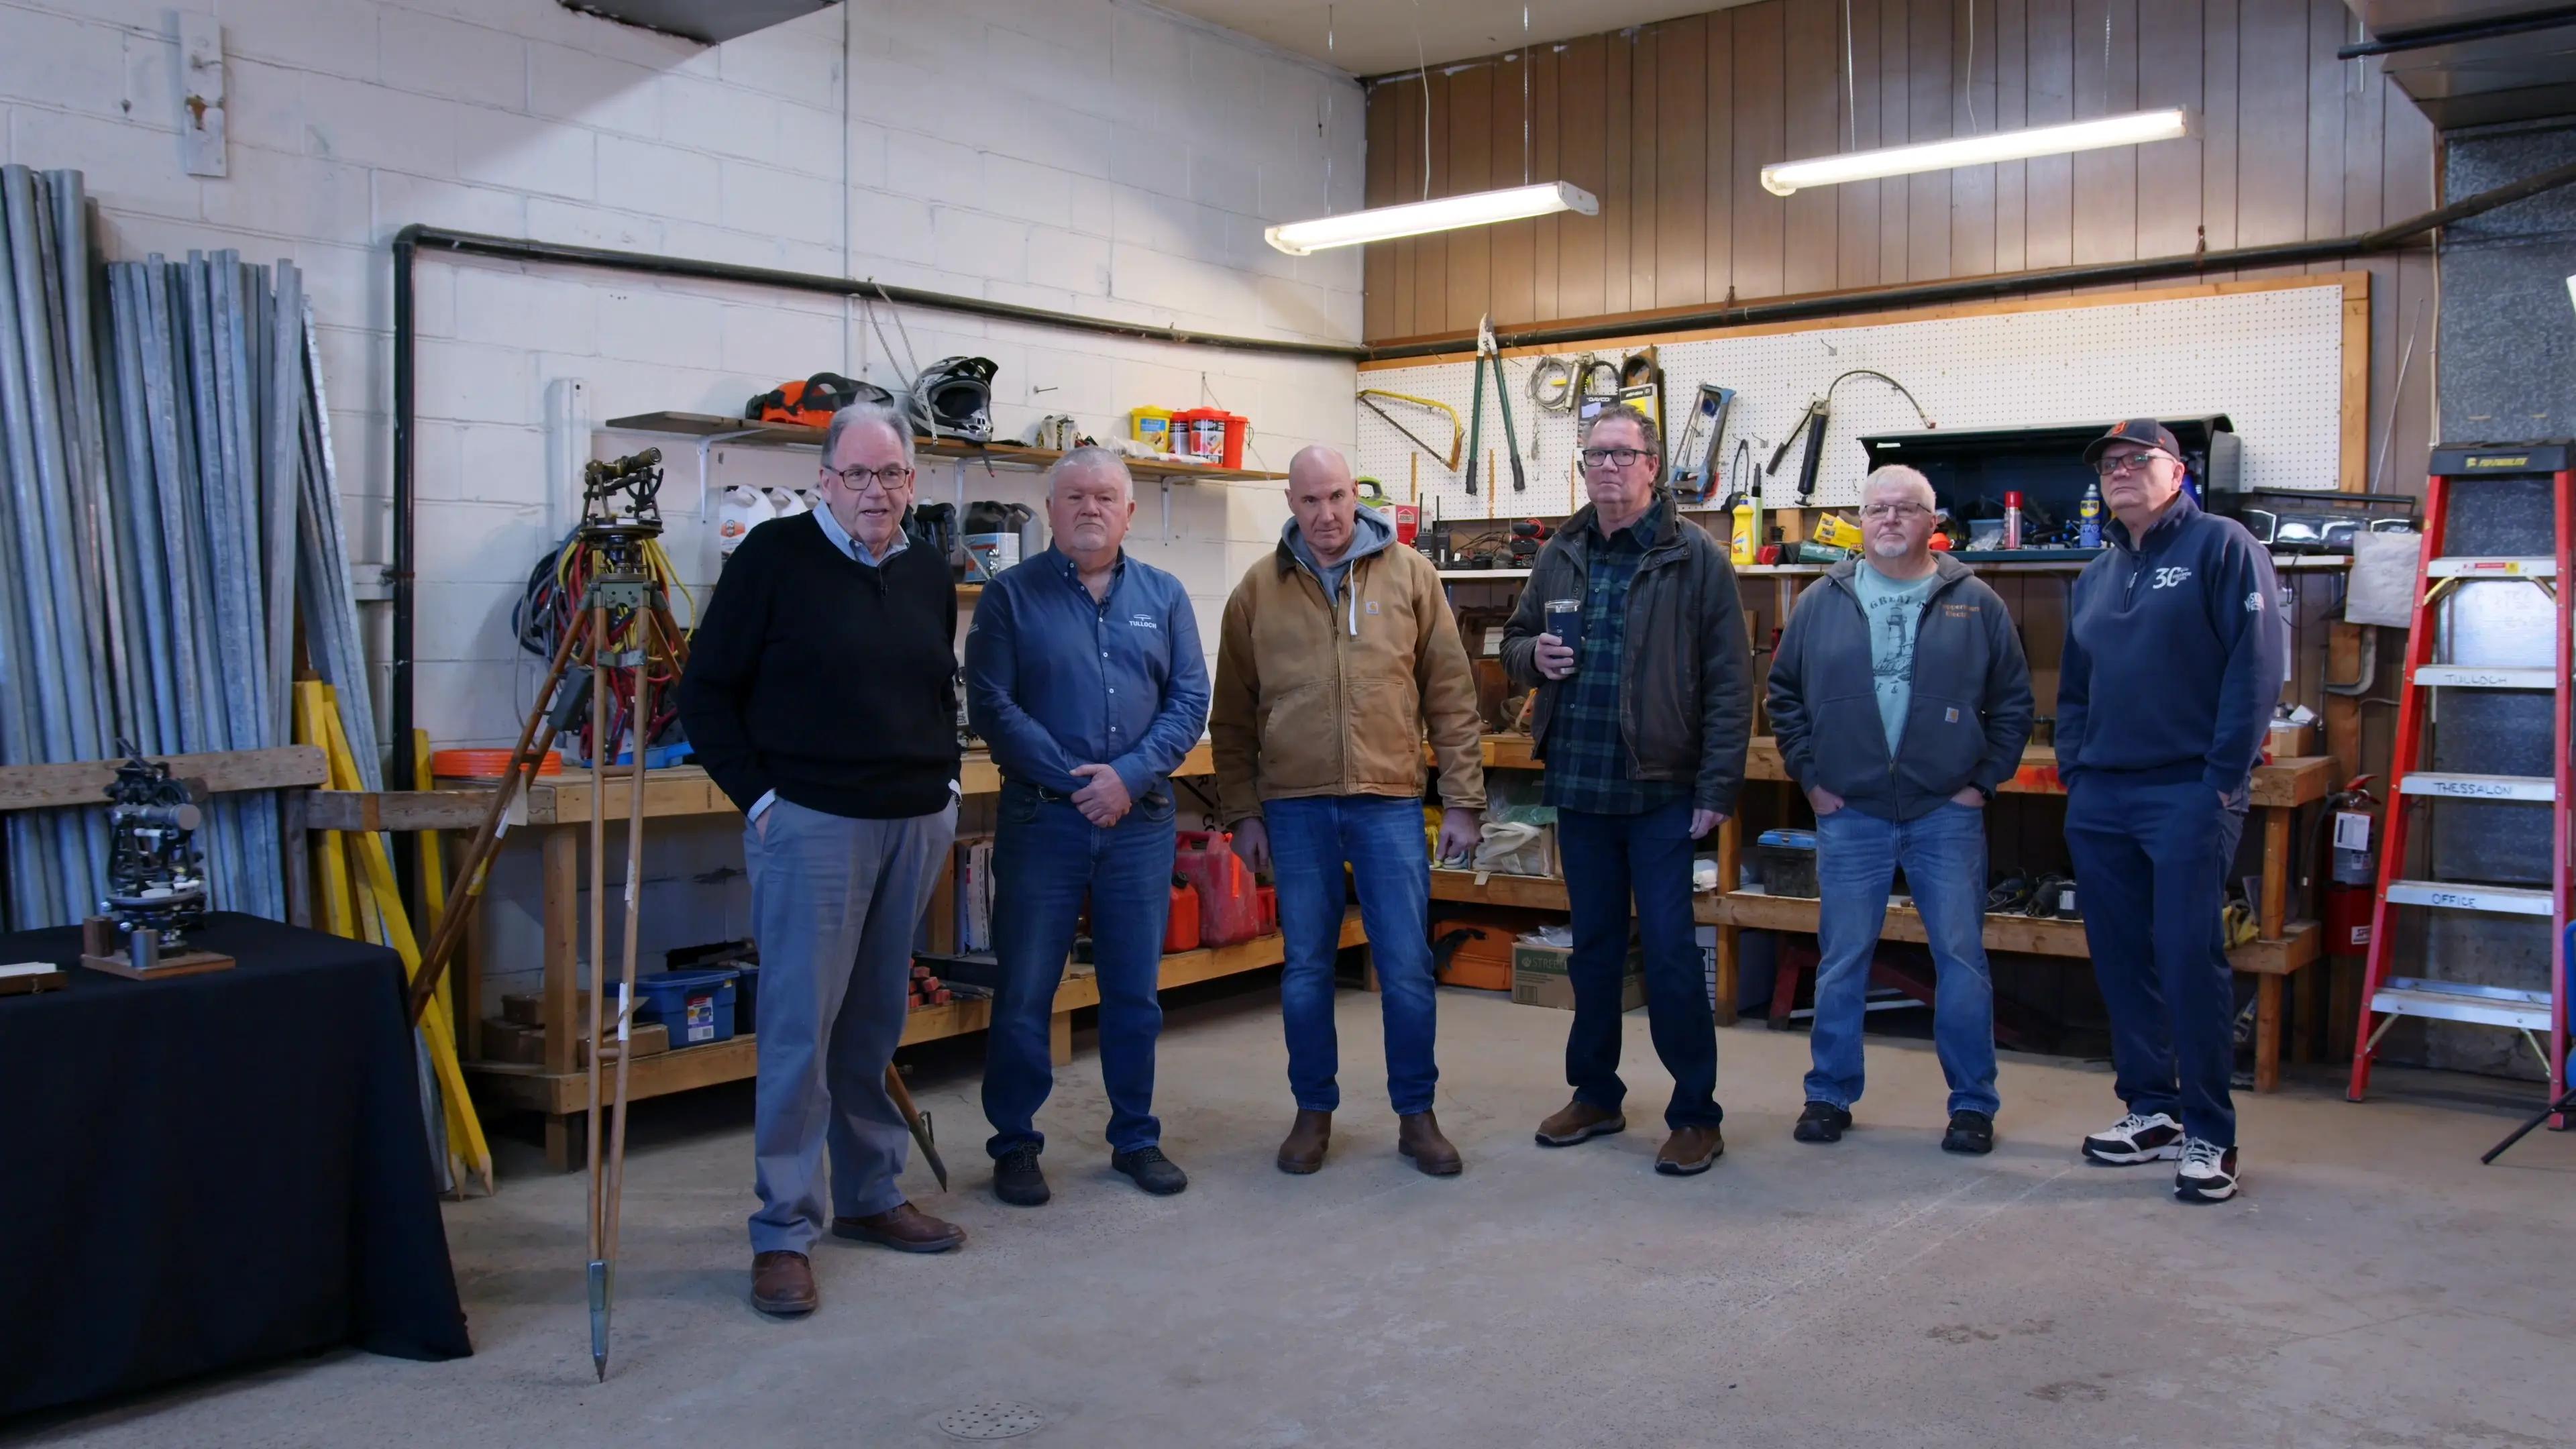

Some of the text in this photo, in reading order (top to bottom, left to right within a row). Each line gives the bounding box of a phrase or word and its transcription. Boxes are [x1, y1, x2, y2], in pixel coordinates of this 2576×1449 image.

[1128, 620, 1157, 629] TULLOCH
[2445, 674, 2508, 685] TULLOCH
[2433, 782, 2513, 796] THESSALON
[2431, 893, 2477, 909] OFFICE
